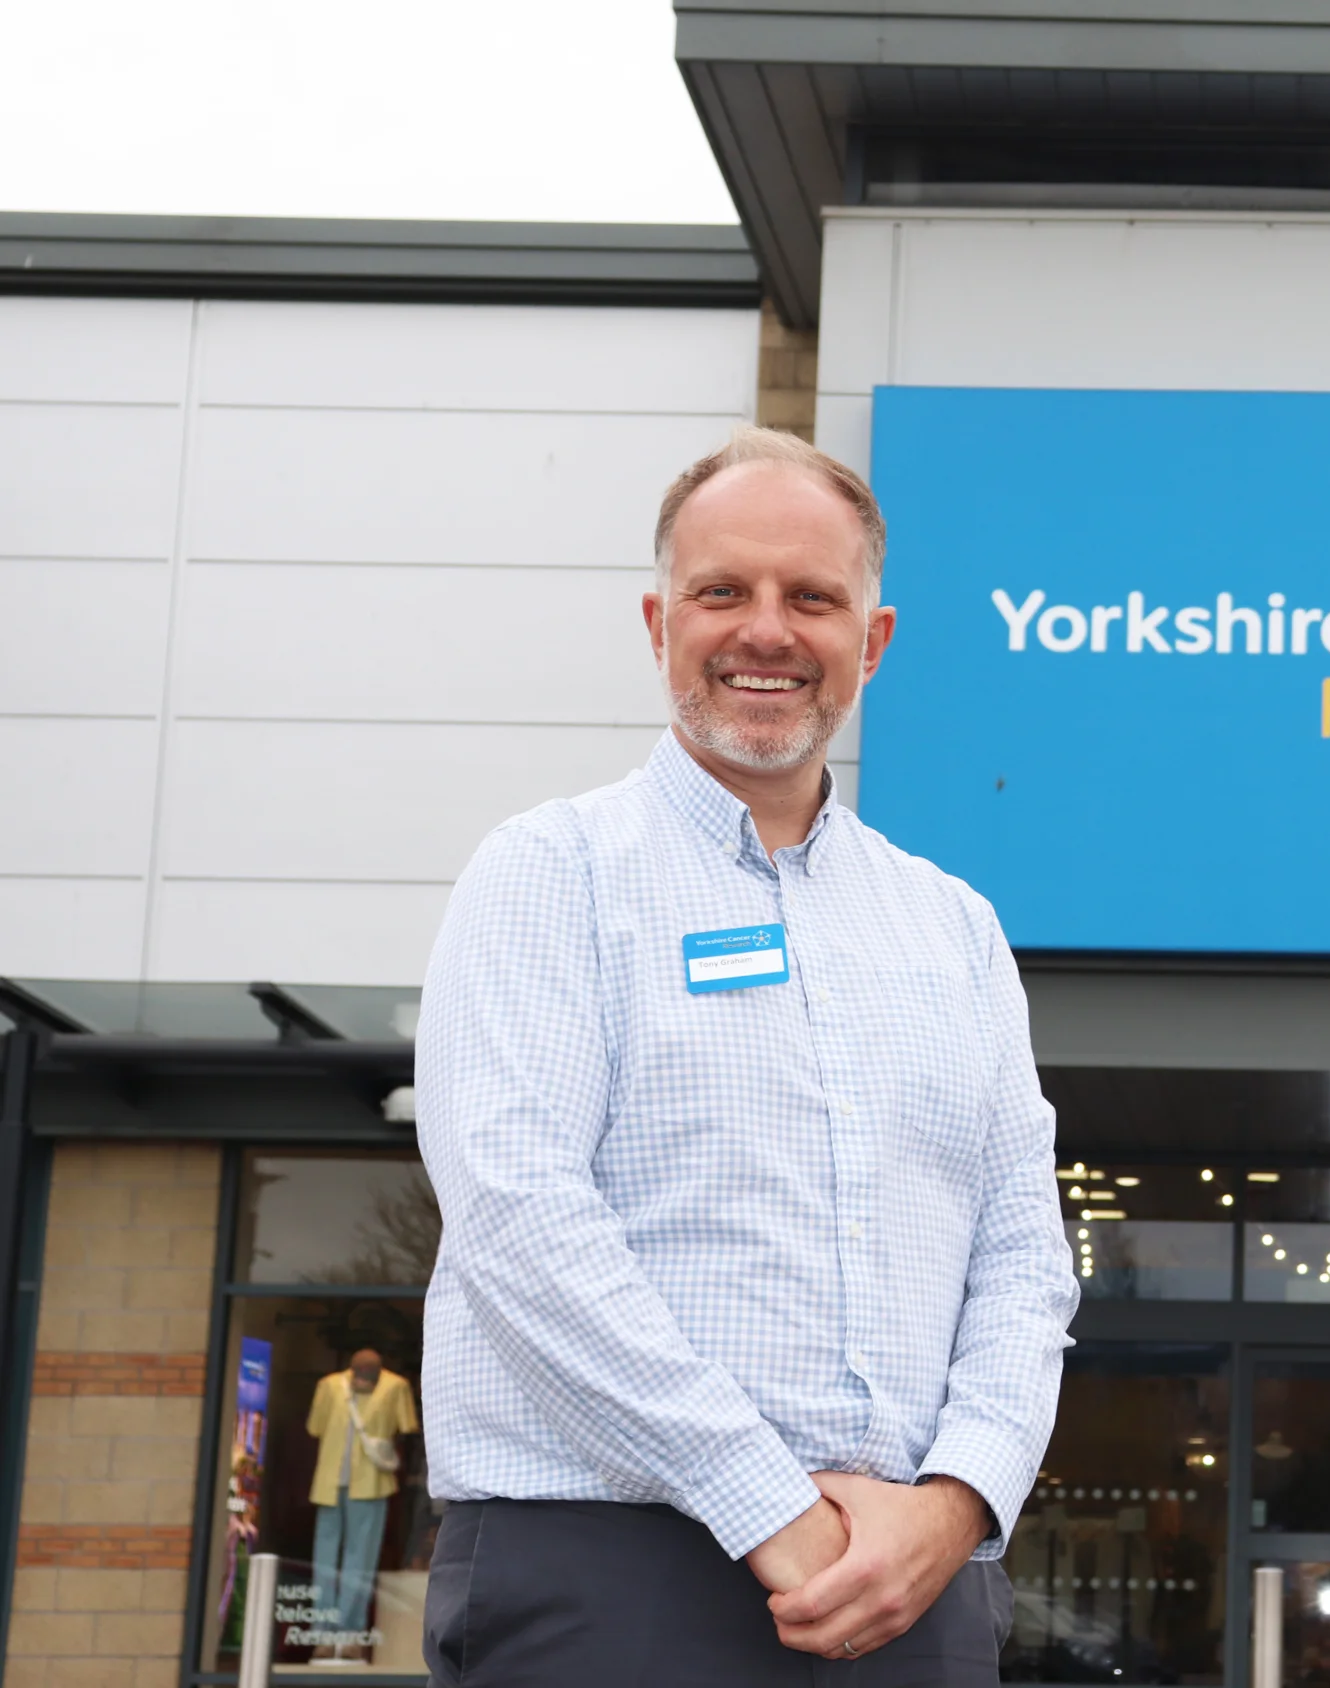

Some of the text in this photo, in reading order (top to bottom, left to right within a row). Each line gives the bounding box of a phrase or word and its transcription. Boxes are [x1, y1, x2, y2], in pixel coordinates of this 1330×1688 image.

[696, 935, 751, 946] Yorkshire Cancer
[699, 957, 753, 969] Tony Graham
